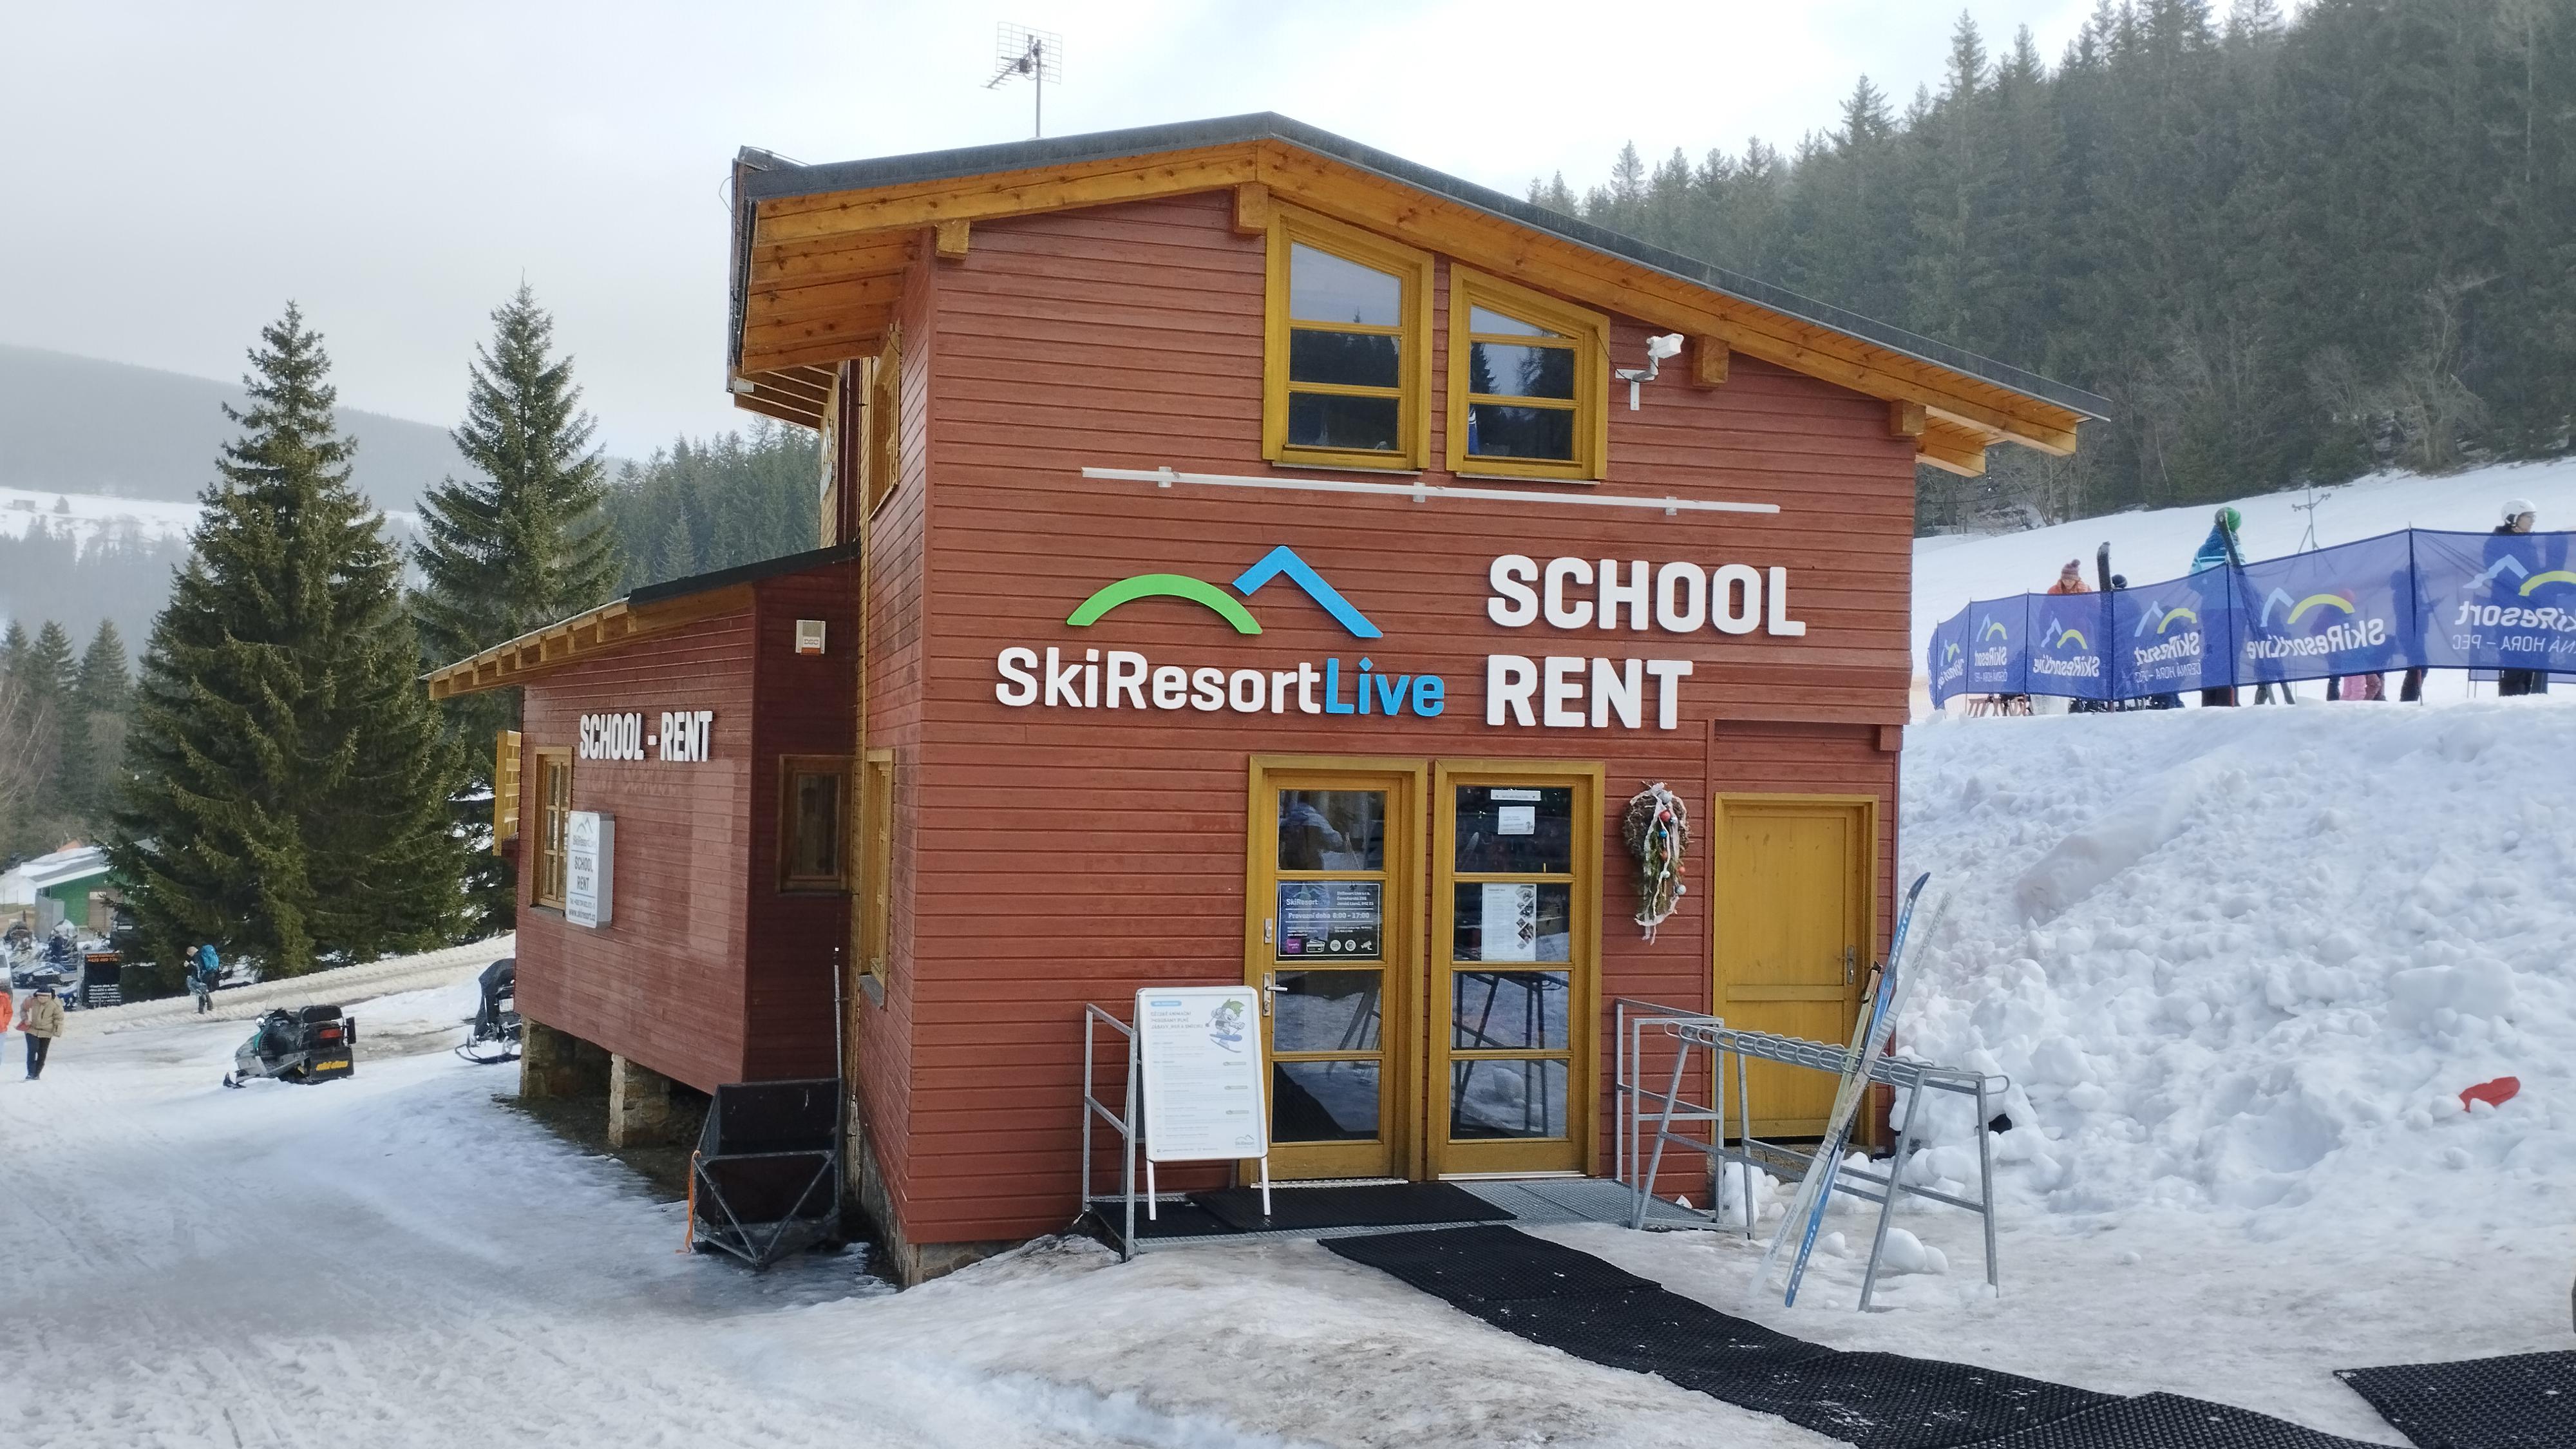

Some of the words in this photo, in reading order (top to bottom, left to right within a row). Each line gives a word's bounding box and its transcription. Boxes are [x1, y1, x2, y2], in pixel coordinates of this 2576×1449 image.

[1488, 554, 1806, 636] SCHOOL
[996, 647, 1445, 718] SkiResortLive
[1487, 654, 1694, 730] RENT
[579, 712, 645, 761] SCHOOL
[660, 710, 713, 762] RENT
[574, 856, 593, 873] SCHOOL
[576, 876, 589, 892] RENT
[1892, 898, 1912, 967] SPORTEN
[1911, 891, 1952, 971] SPORTEN
